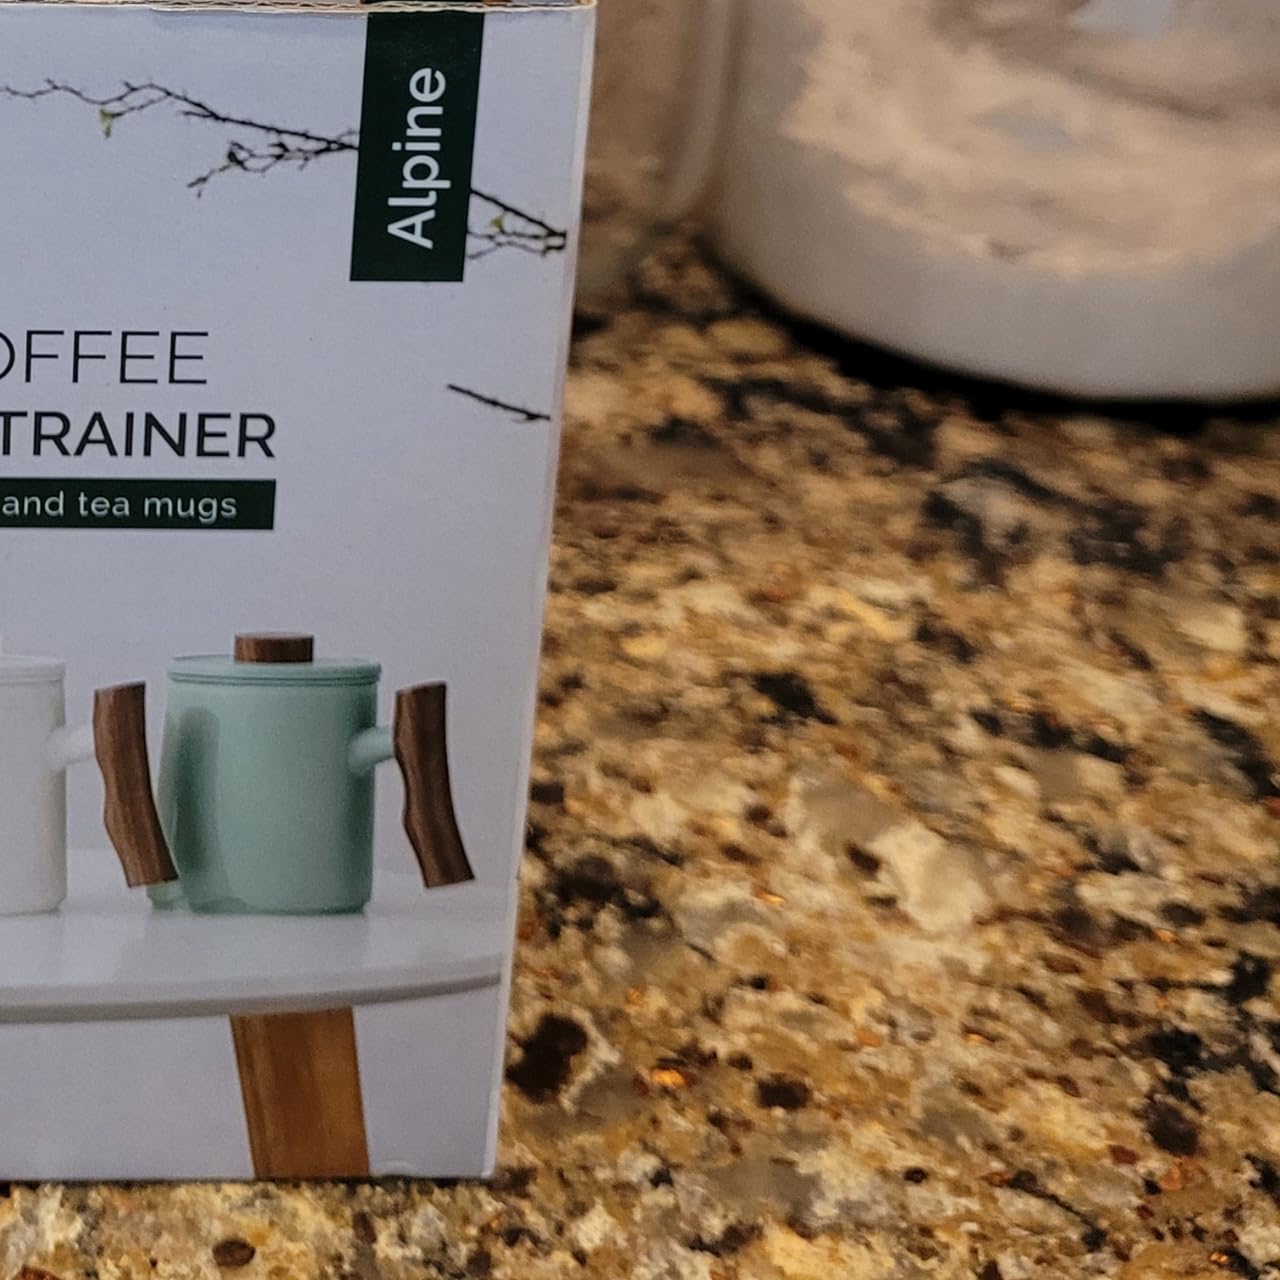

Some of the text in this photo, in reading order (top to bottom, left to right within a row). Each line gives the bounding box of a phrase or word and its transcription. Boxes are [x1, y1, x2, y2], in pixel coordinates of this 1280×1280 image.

[387, 67, 452, 250] Alpine
[1, 489, 65, 517] and
[77, 491, 130, 518] tea
[143, 496, 237, 524] mugs
